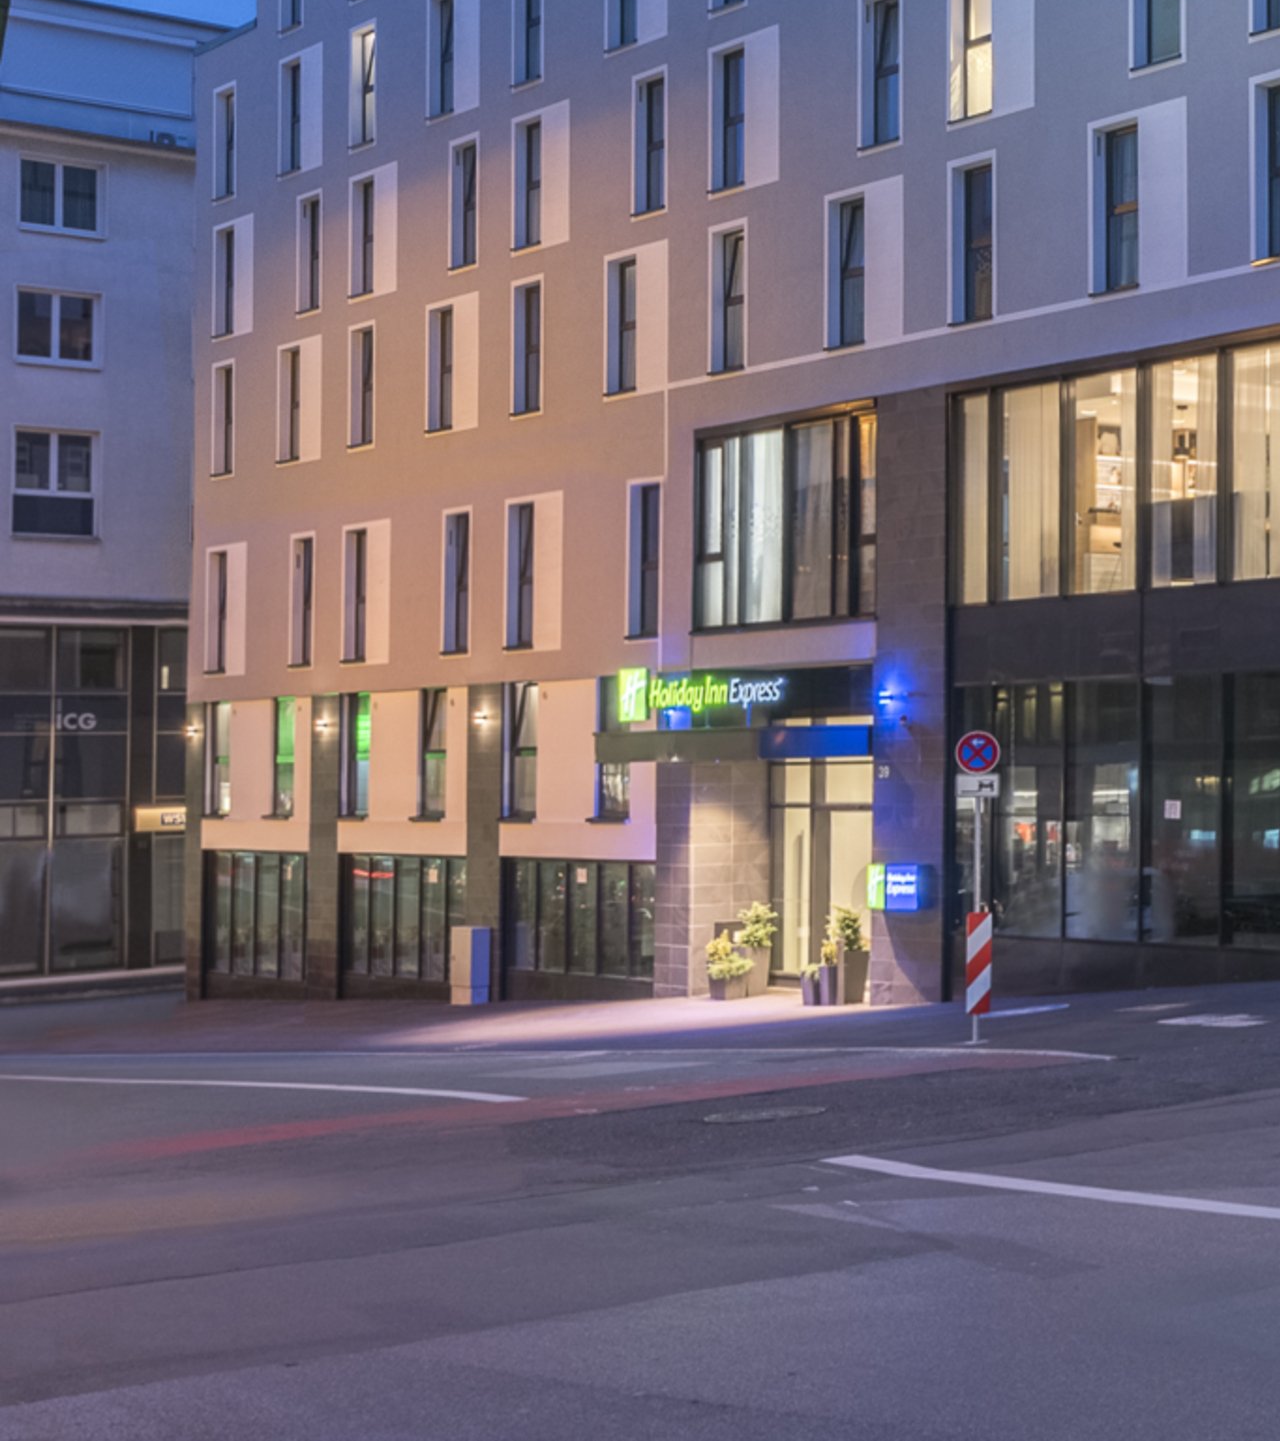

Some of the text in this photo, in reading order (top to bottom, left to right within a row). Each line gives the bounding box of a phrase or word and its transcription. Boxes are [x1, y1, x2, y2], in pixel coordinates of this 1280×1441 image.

[650, 674, 780, 713] Holiday Inn Express
